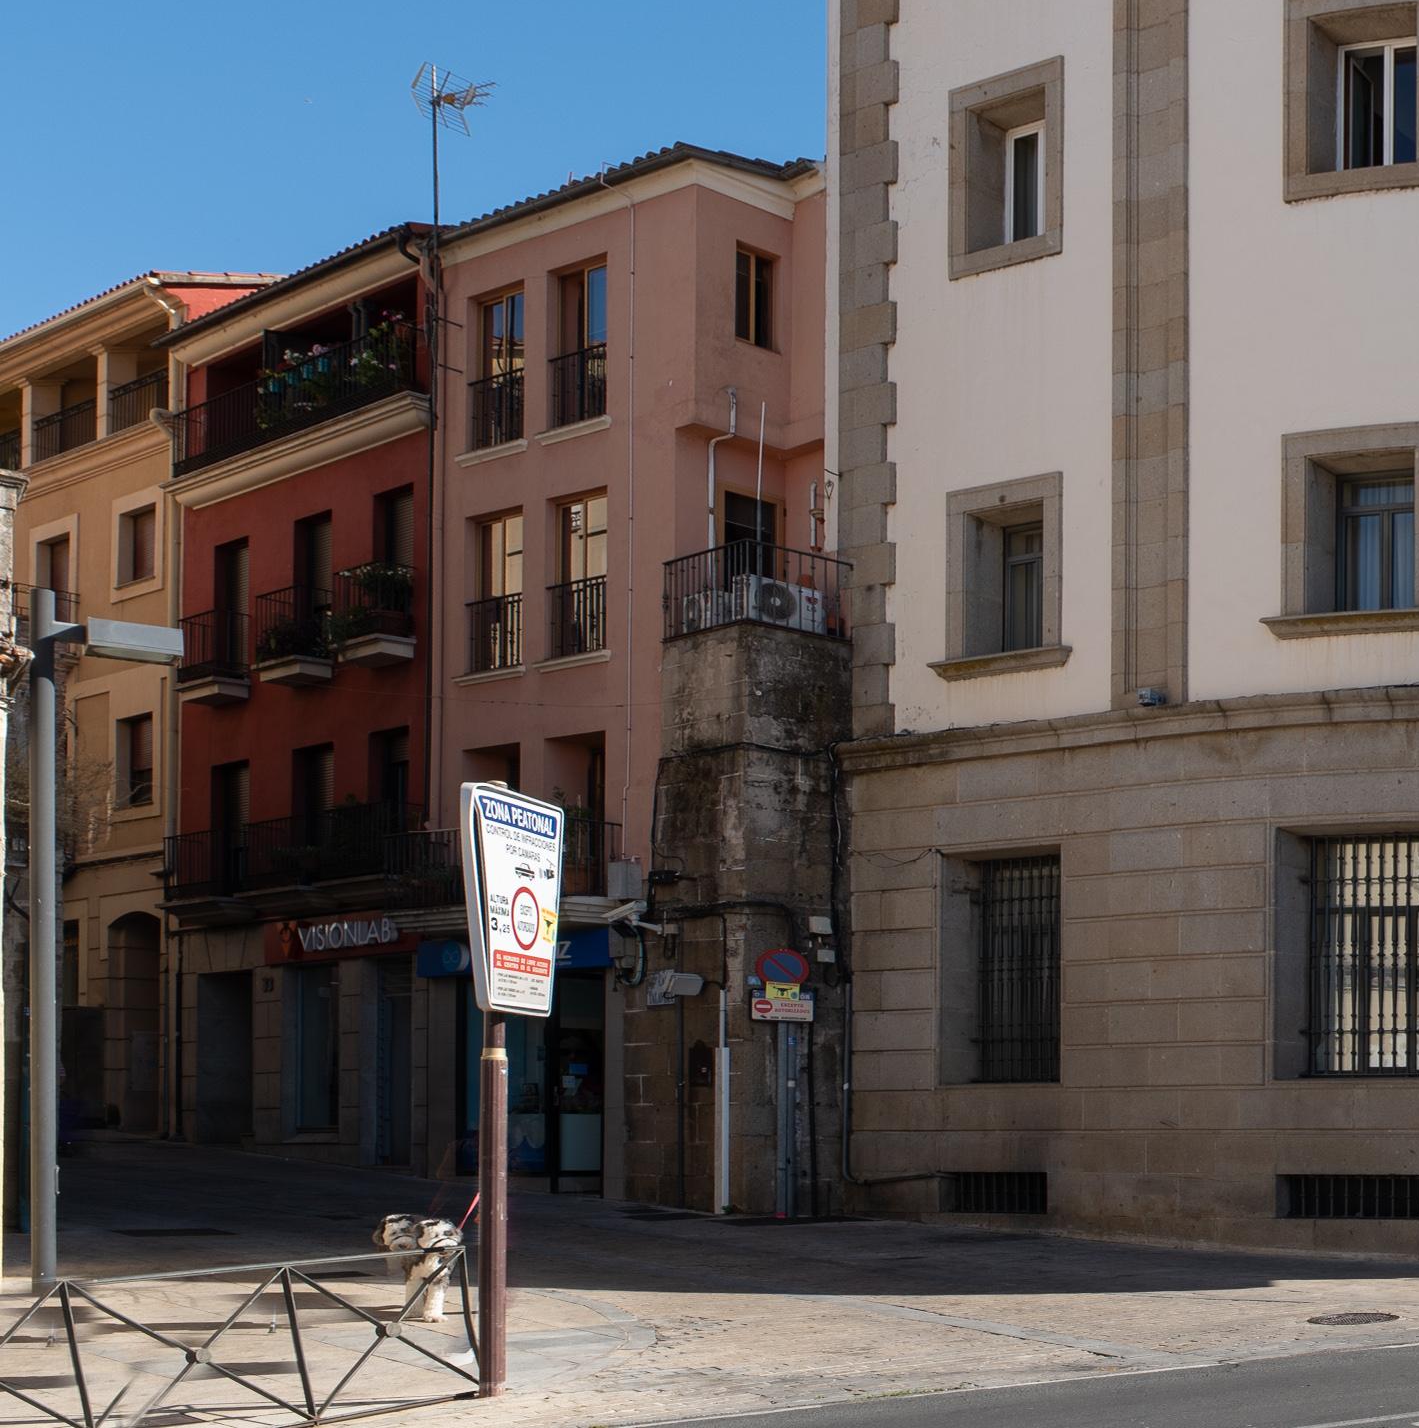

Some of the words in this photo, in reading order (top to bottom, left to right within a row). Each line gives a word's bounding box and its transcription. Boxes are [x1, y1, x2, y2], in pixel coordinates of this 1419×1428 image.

[482, 798, 511, 824] ZONA
[511, 806, 555, 837] PEATONAL
[486, 823, 512, 840] CONTROL
[513, 830, 521, 842] DE
[522, 833, 556, 853] INFRACCIONES
[505, 843, 517, 855] POR
[490, 893, 509, 905] ALTURA
[298, 918, 391, 952] VISIONLAB
